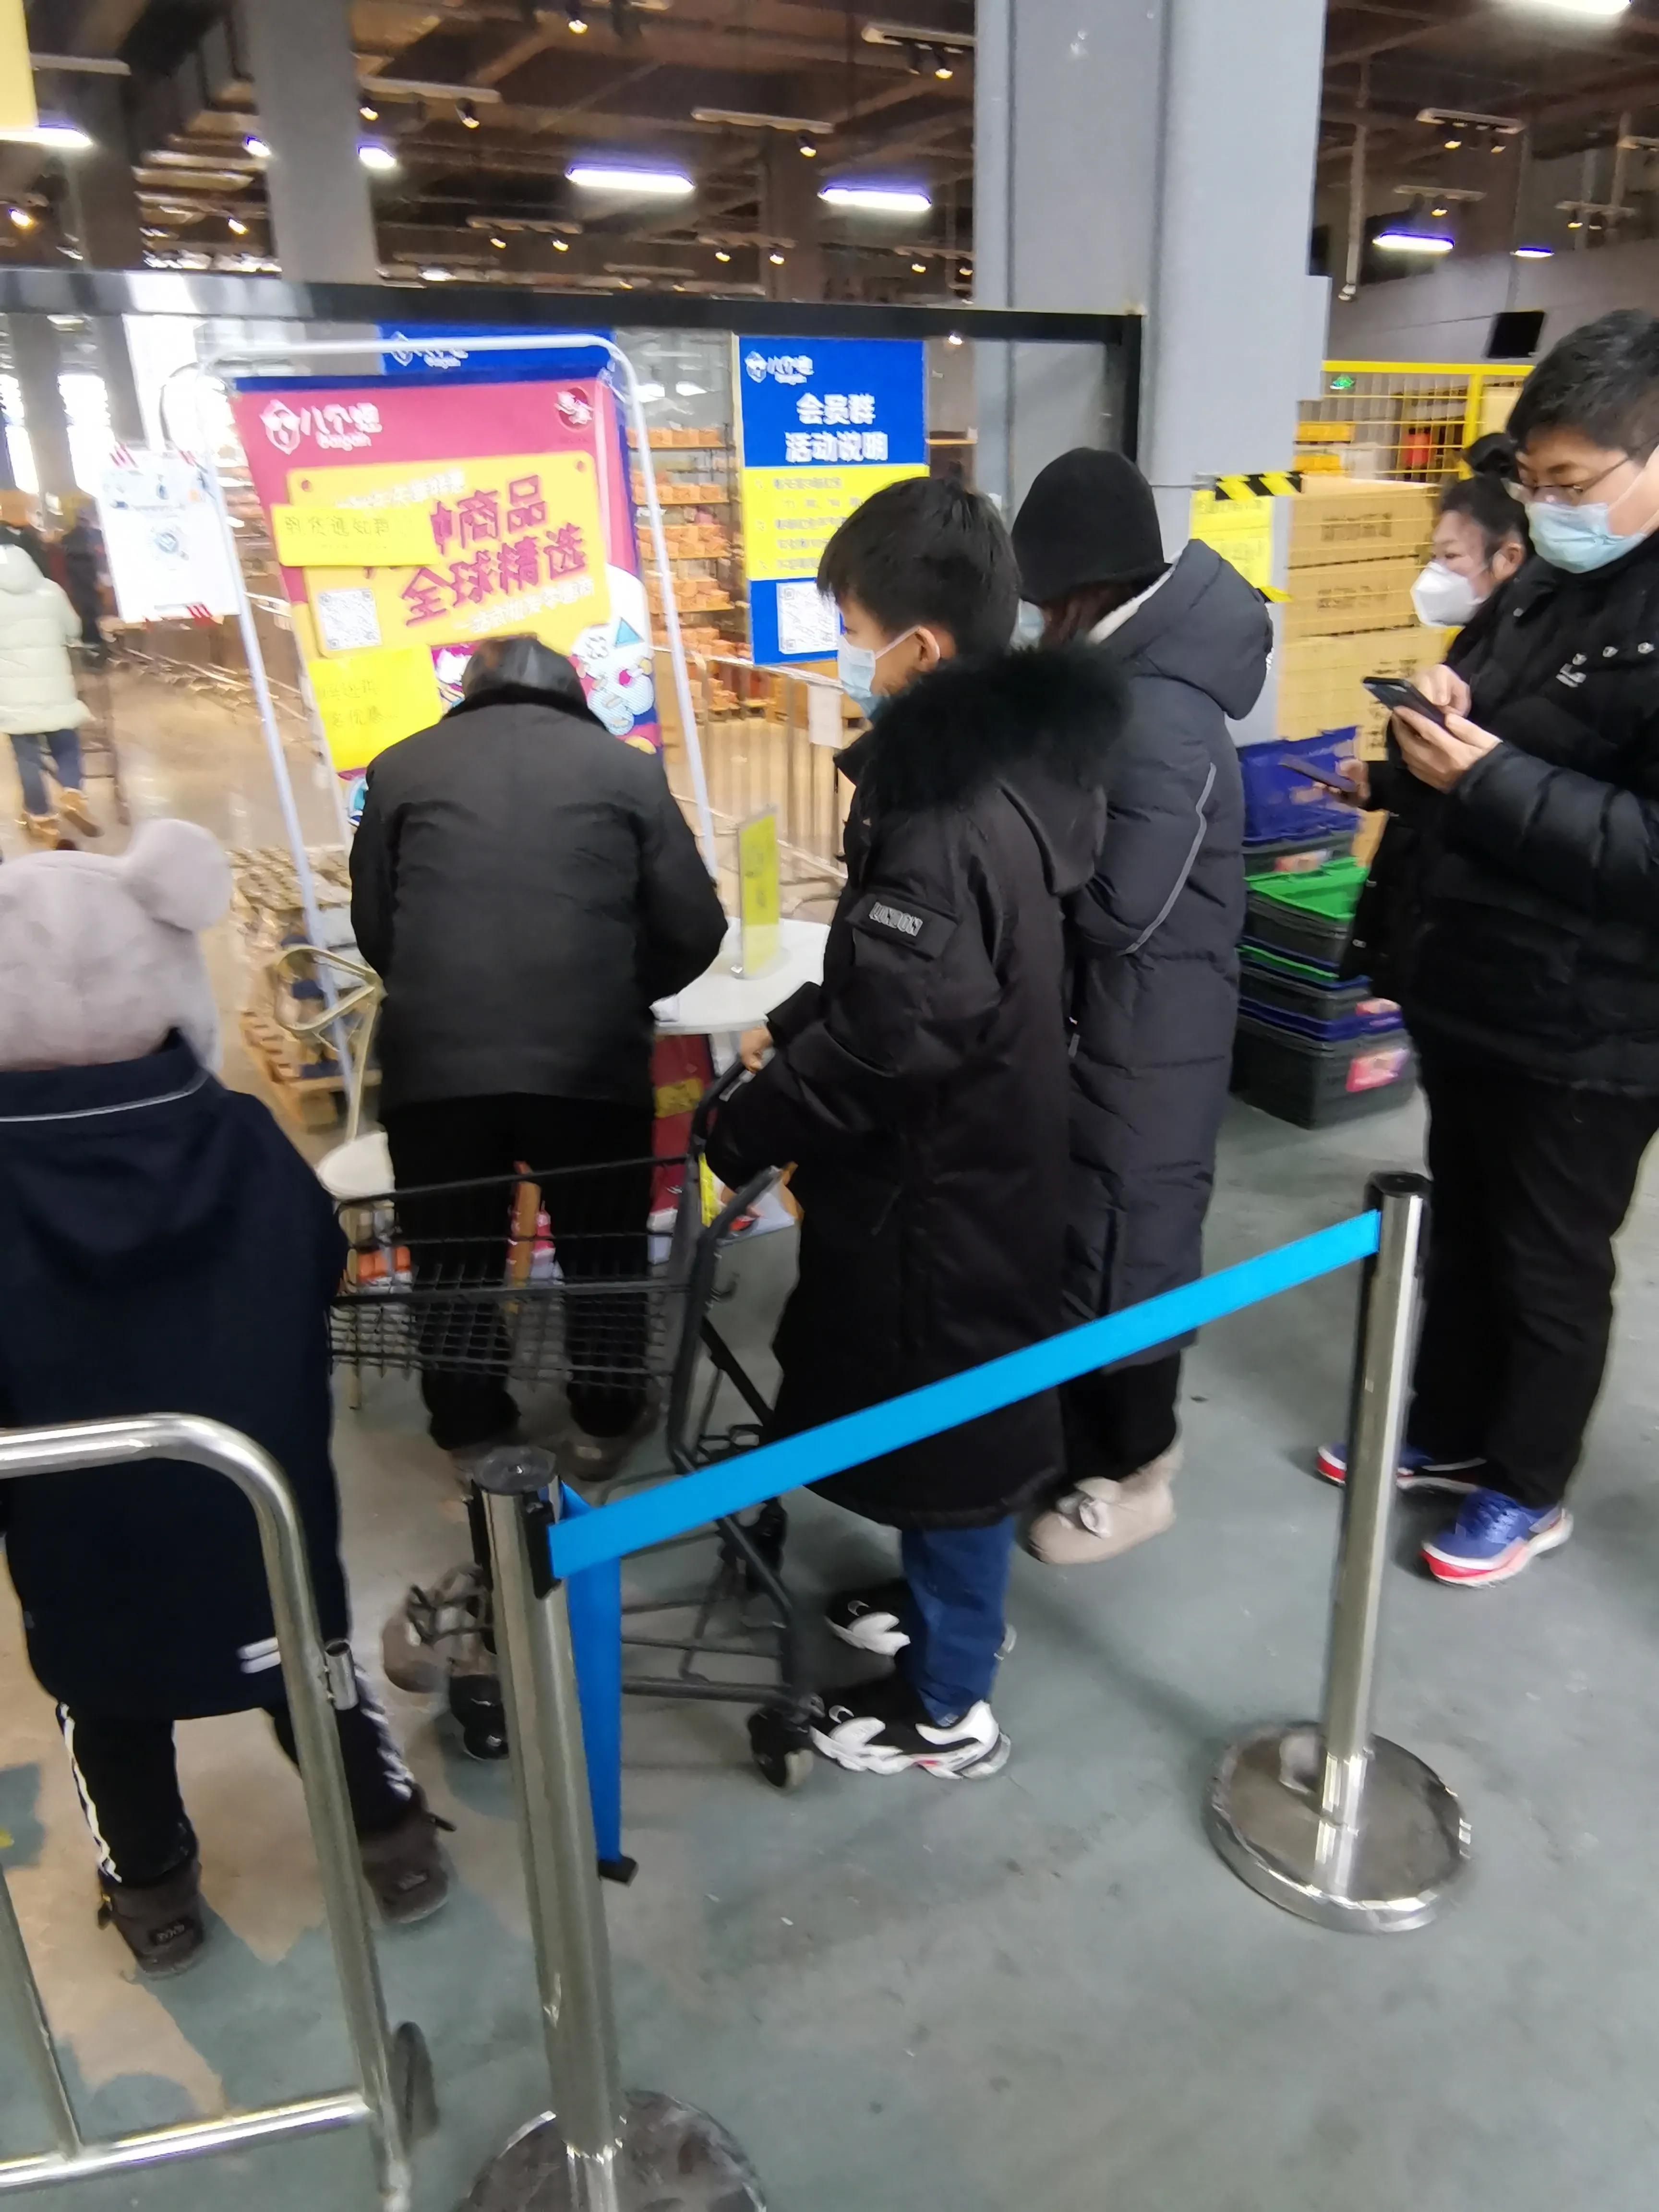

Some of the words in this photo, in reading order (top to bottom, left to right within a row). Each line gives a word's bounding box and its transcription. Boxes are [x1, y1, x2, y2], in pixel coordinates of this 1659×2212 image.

[796, 392, 876, 425] 会员群
[784, 431, 889, 463] 活动说明
[401, 522, 587, 626] 全球精选
